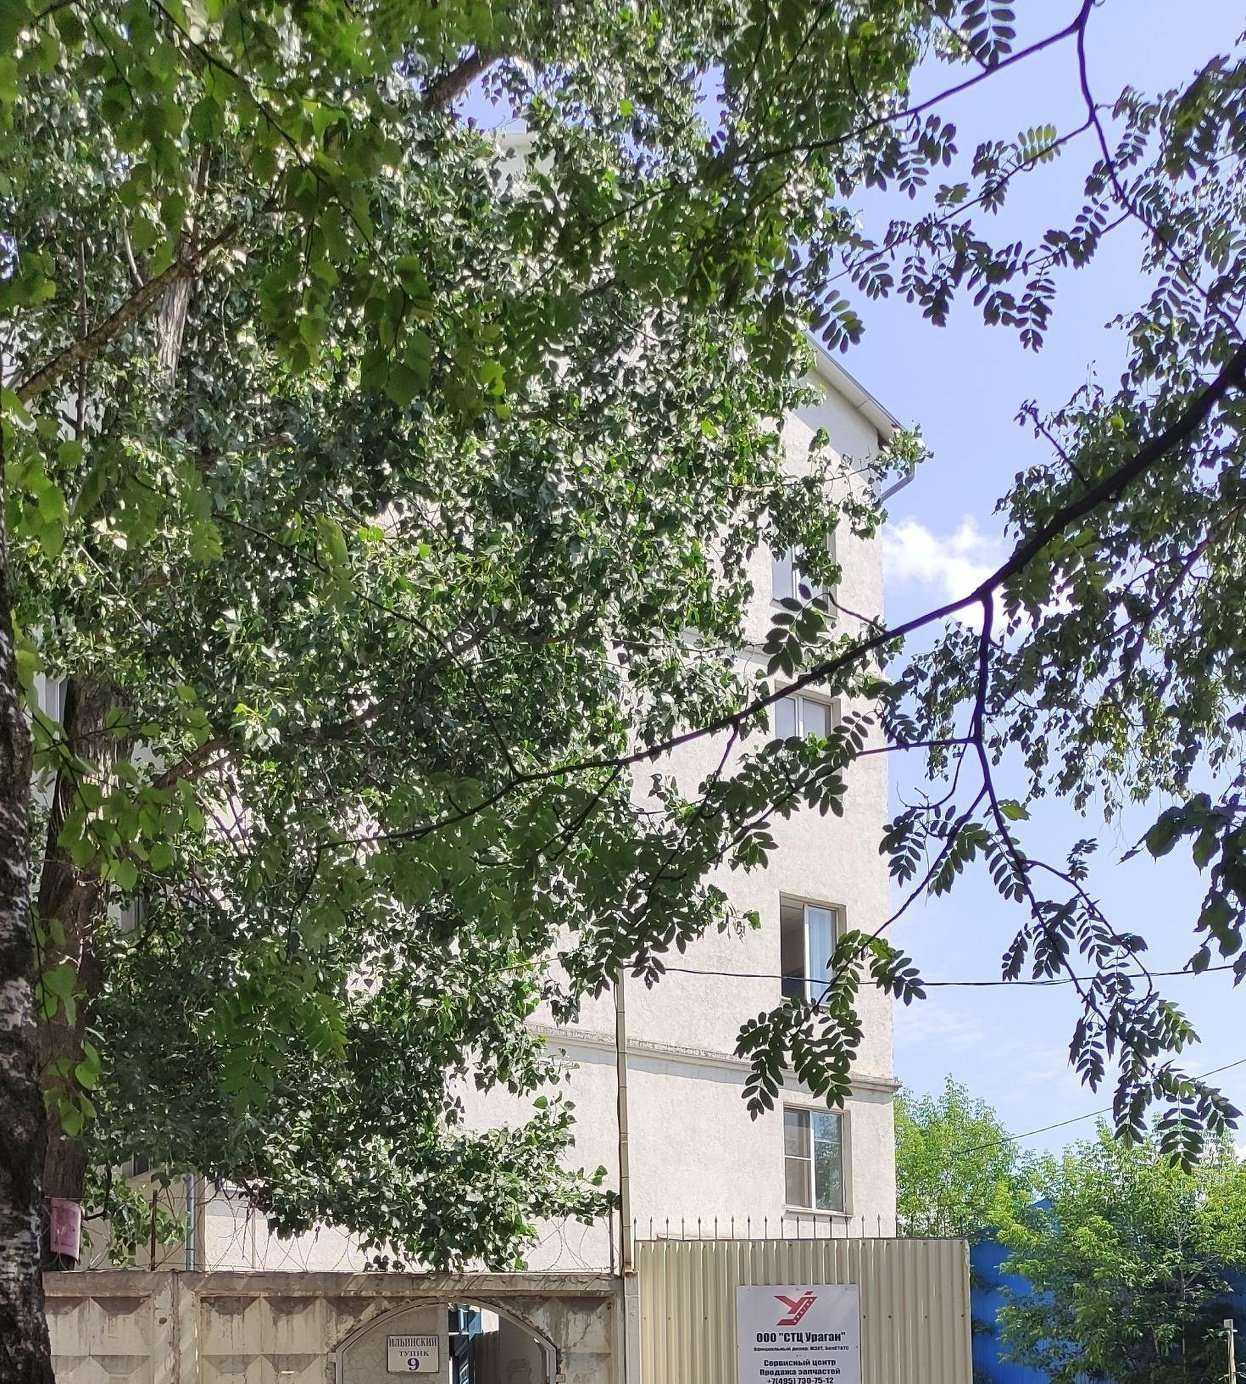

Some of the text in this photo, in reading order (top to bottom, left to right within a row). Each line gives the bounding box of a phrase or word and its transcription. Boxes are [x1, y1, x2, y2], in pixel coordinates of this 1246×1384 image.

[756, 1331, 846, 1343] ООО "СТЦ Ураган"
[407, 1357, 420, 1371] 9
[763, 1359, 837, 1367] Сервисный центр
[759, 1367, 841, 1376] Продажа запчастей
[768, 1377, 796, 1384] +7(495)
